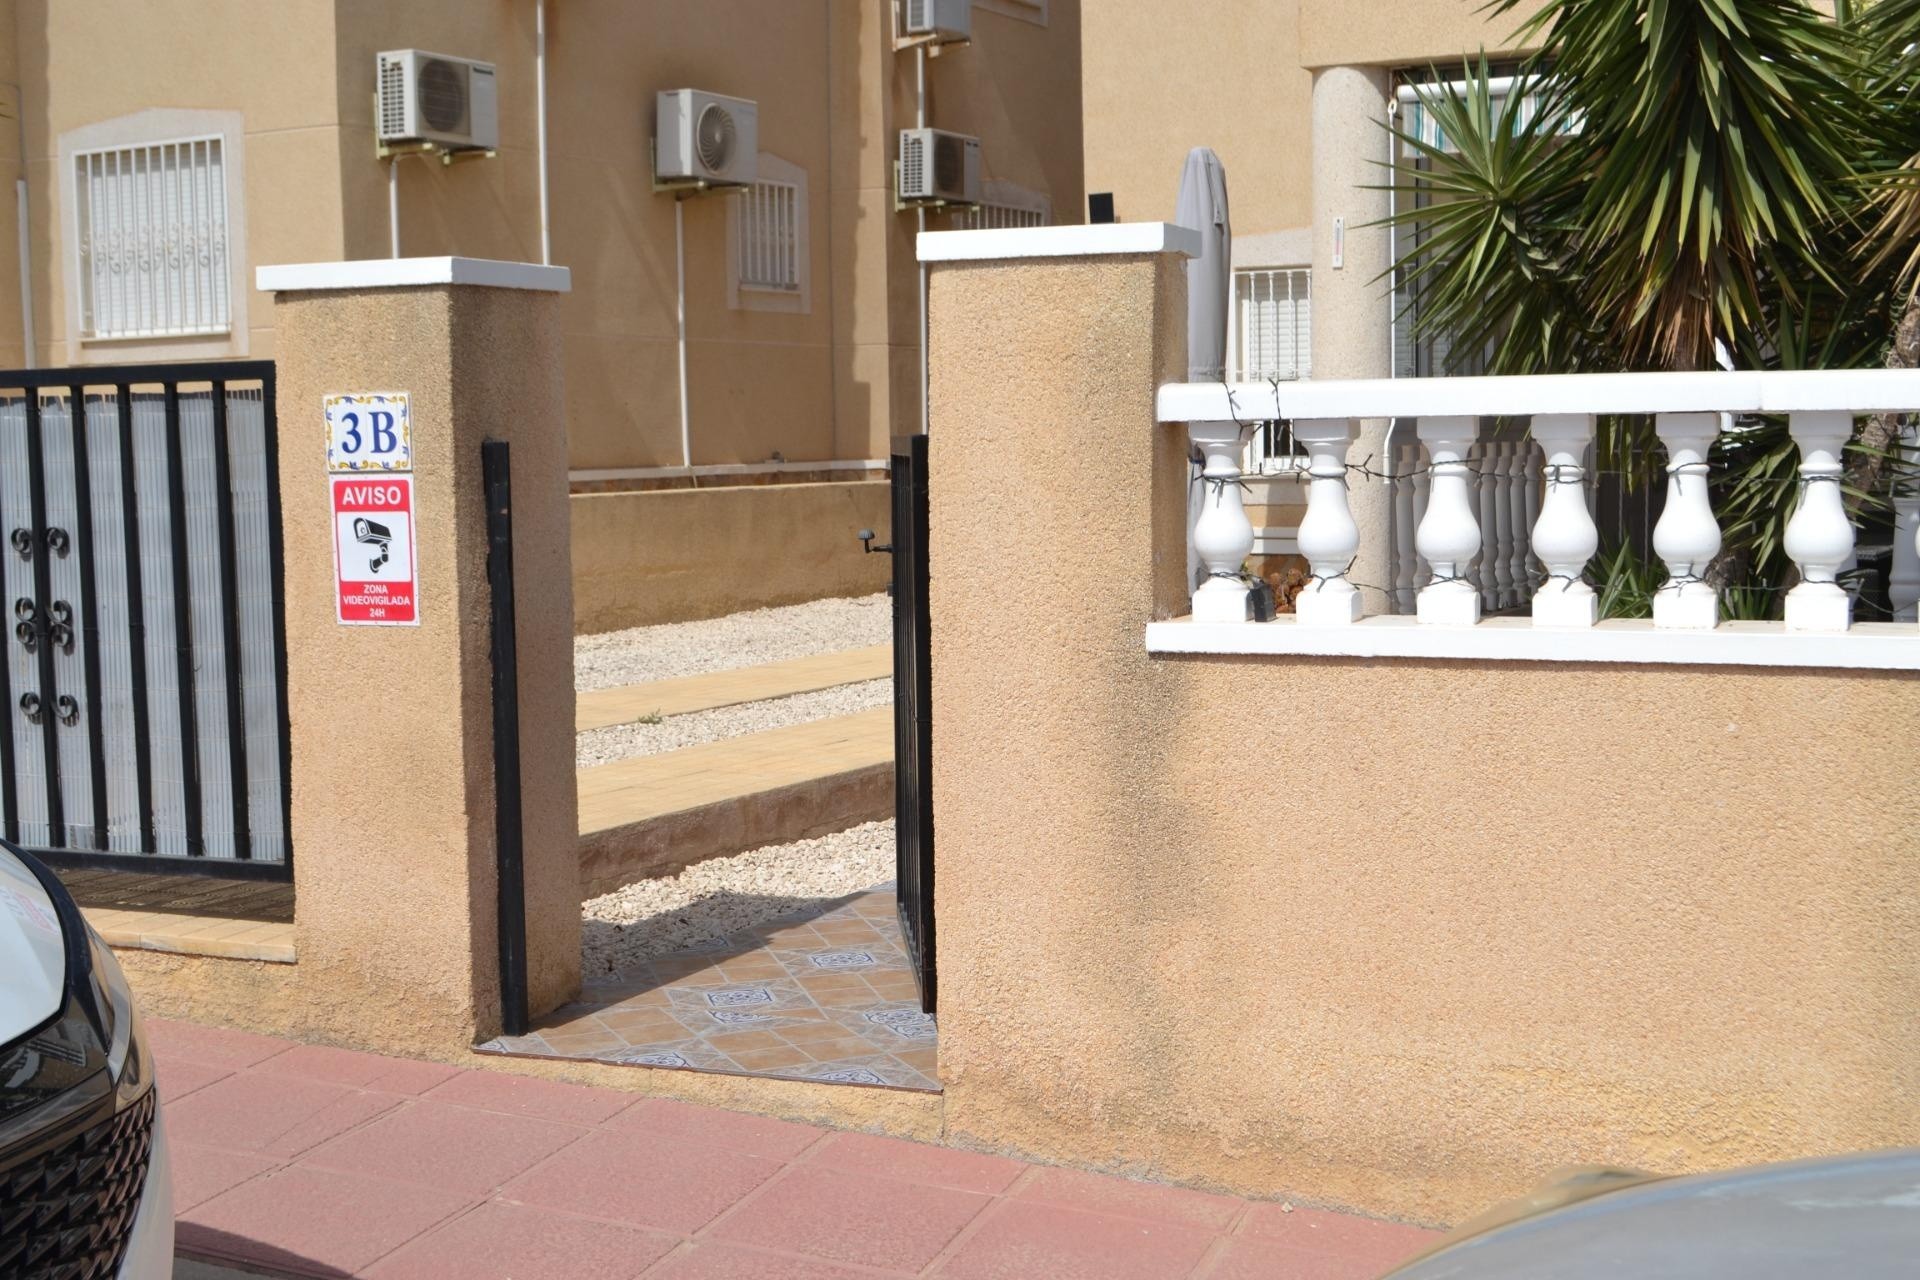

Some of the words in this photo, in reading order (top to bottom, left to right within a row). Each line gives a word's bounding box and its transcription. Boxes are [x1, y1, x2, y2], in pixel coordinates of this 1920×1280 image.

[341, 411, 397, 454] 3B
[342, 487, 402, 505] AVISO
[363, 584, 388, 595] ZONA
[343, 593, 410, 606] VIDEOVIGILADA
[369, 608, 385, 618] 24H
